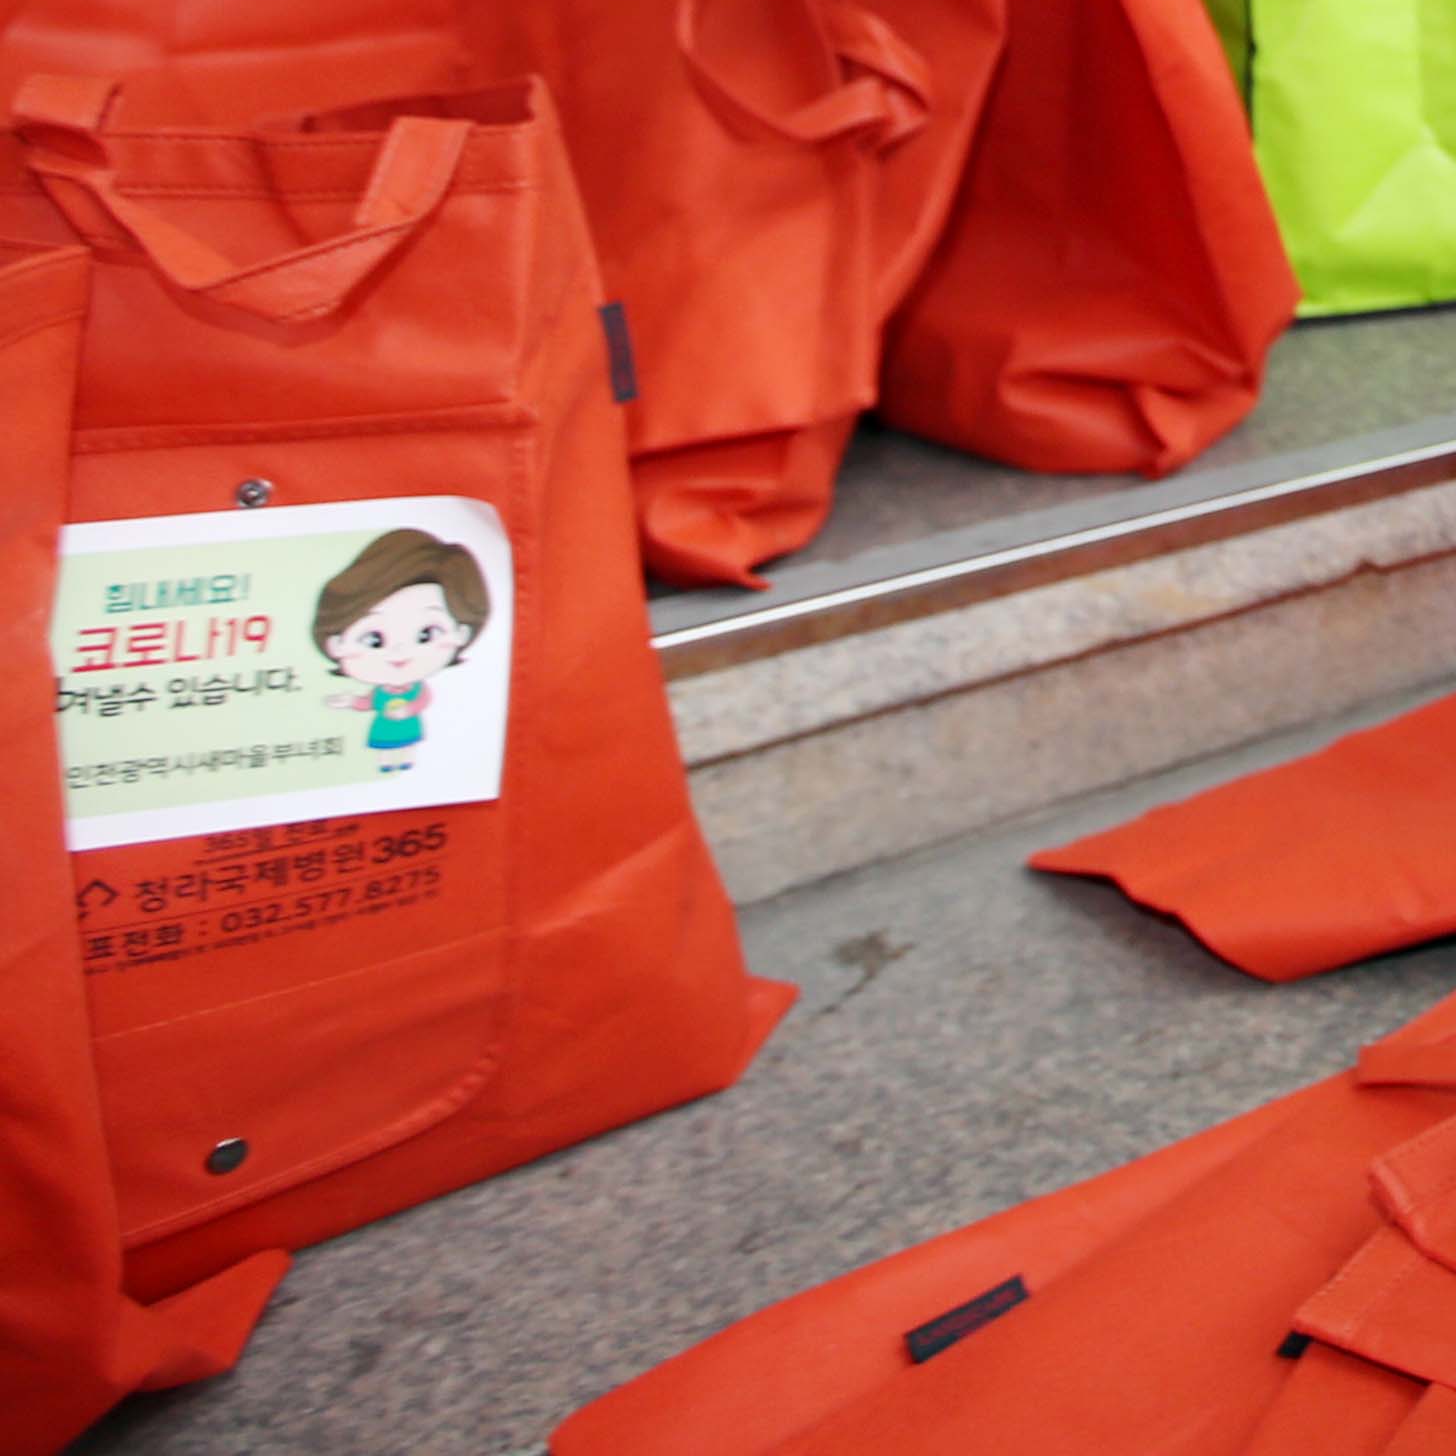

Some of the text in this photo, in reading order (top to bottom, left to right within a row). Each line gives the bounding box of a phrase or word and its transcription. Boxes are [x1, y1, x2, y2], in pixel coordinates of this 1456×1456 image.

[104, 574, 251, 614] 힘내세요!
[69, 614, 272, 674] 코로나19
[55, 667, 302, 717] 겨낼수 있습니다.
[84, 922, 184, 963] 표전화
